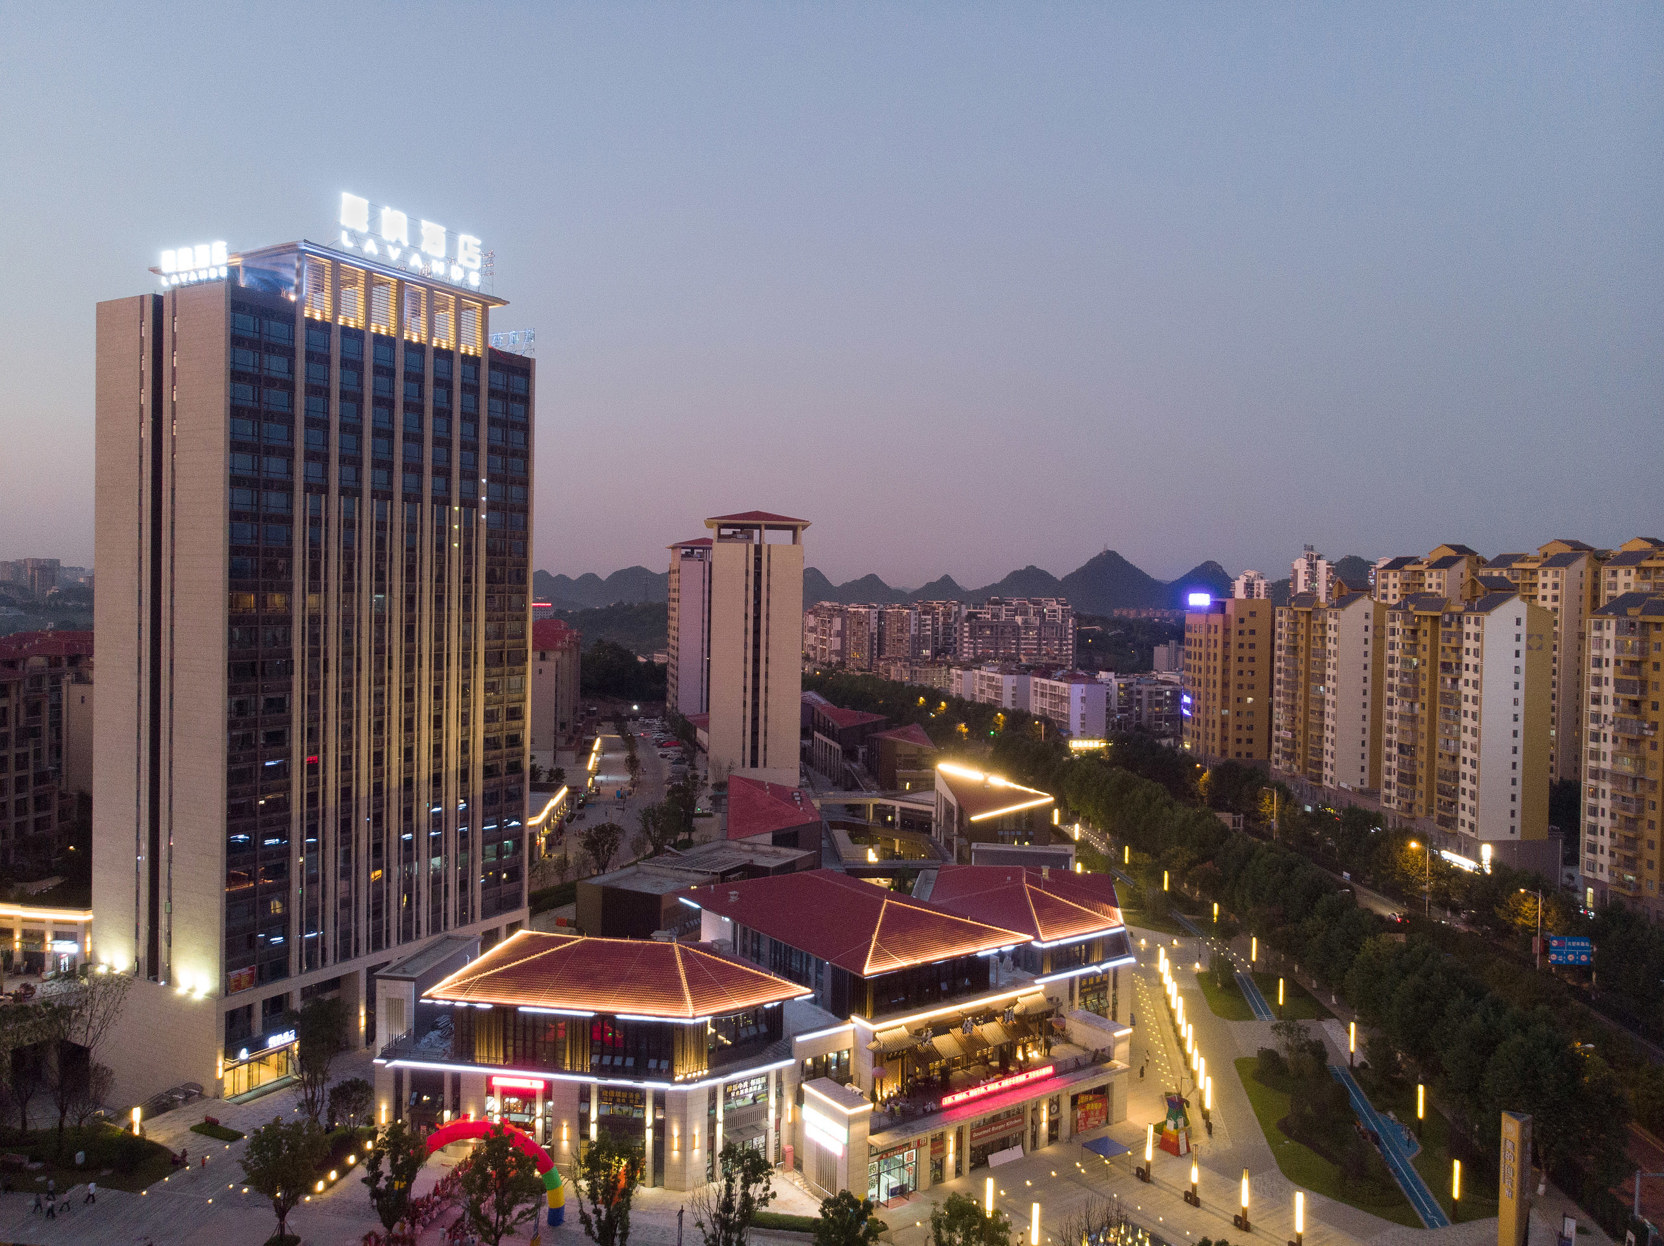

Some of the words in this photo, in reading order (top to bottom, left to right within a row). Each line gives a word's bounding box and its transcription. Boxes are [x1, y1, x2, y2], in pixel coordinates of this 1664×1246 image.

[341, 231, 480, 286] LAVANDE
[972, 1126, 991, 1138] Gourmet
[991, 1122, 1006, 1132] Burger
[1006, 1118, 1022, 1127] Kitchen
